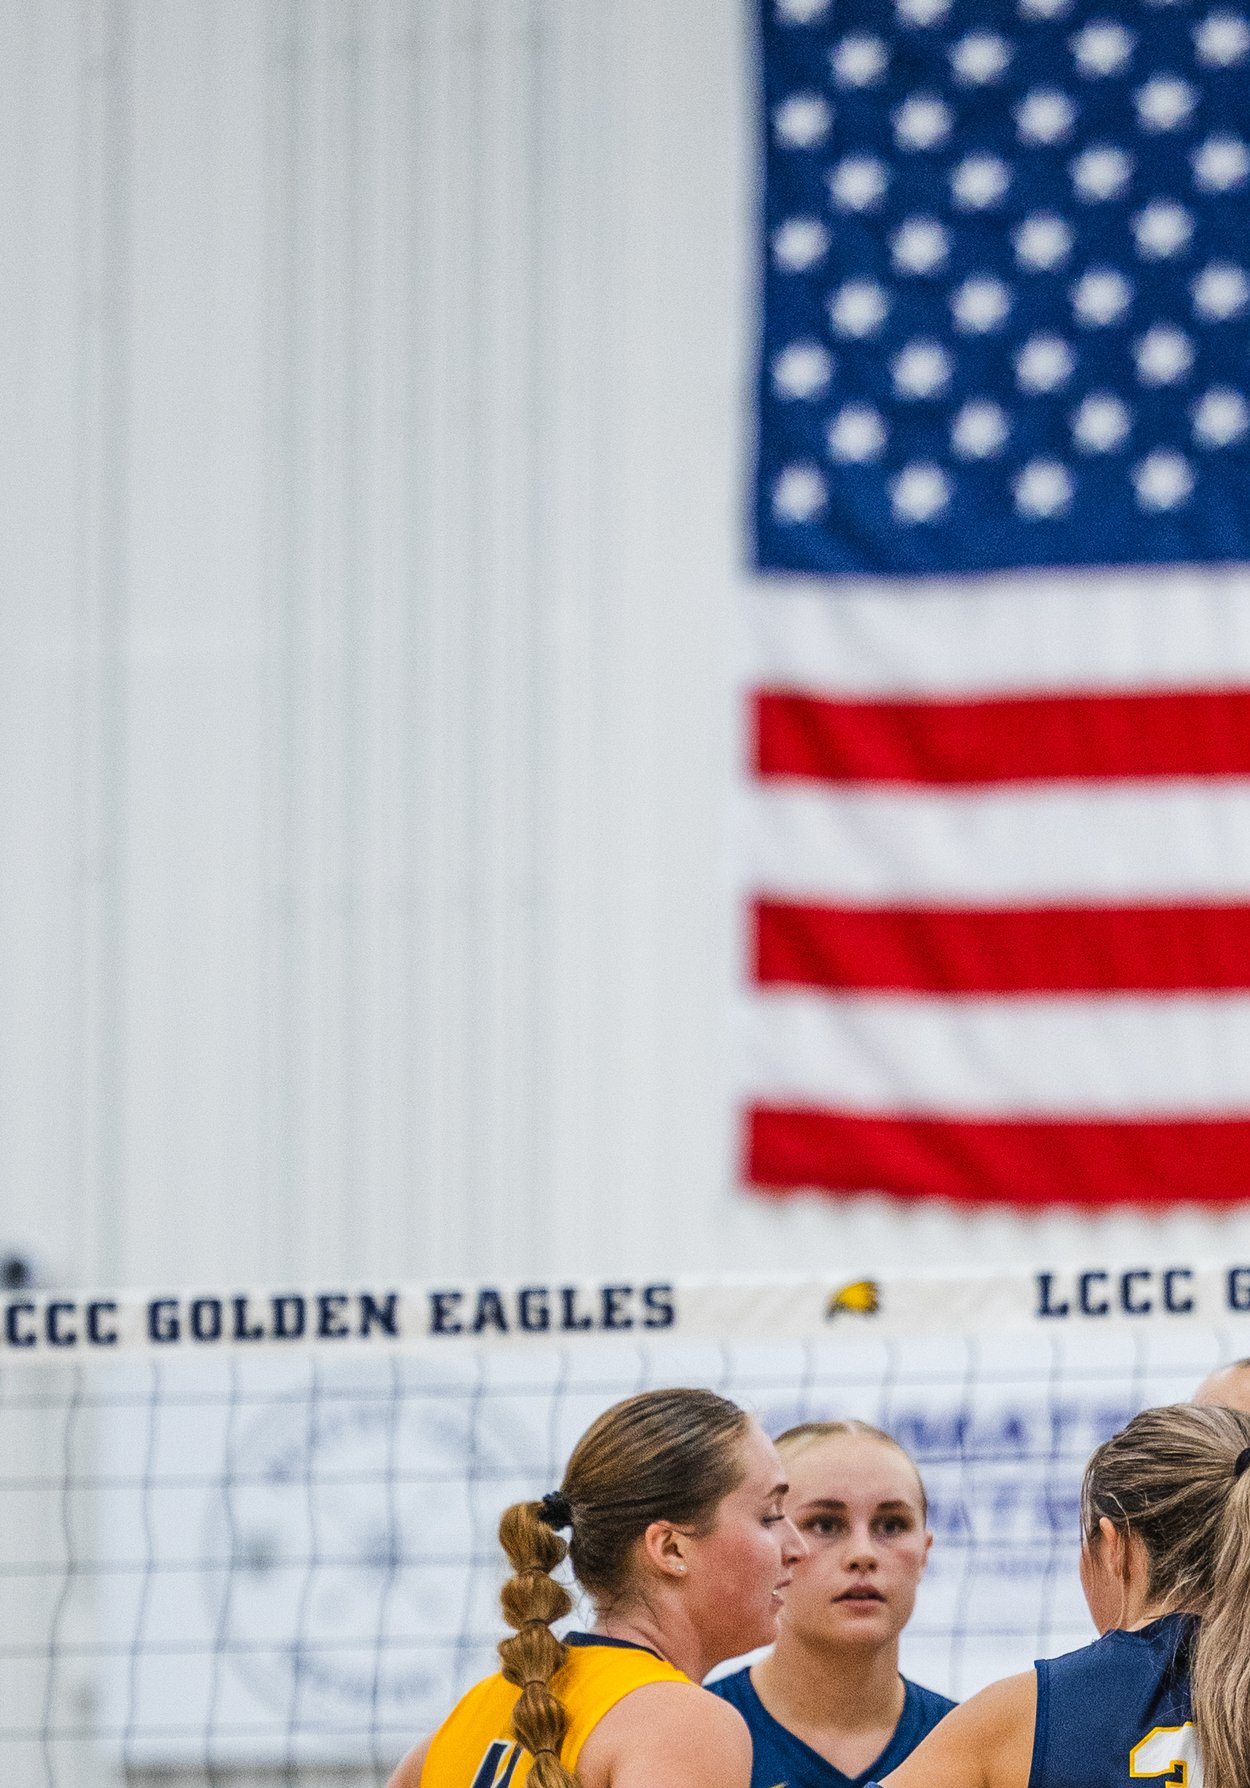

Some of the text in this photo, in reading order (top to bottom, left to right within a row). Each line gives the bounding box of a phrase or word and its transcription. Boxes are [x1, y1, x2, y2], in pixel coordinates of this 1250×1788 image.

[147, 1293, 399, 1344] GOLDEN
[430, 1285, 675, 1335] EAGLES
[1037, 1269, 1194, 1317] LCCC
